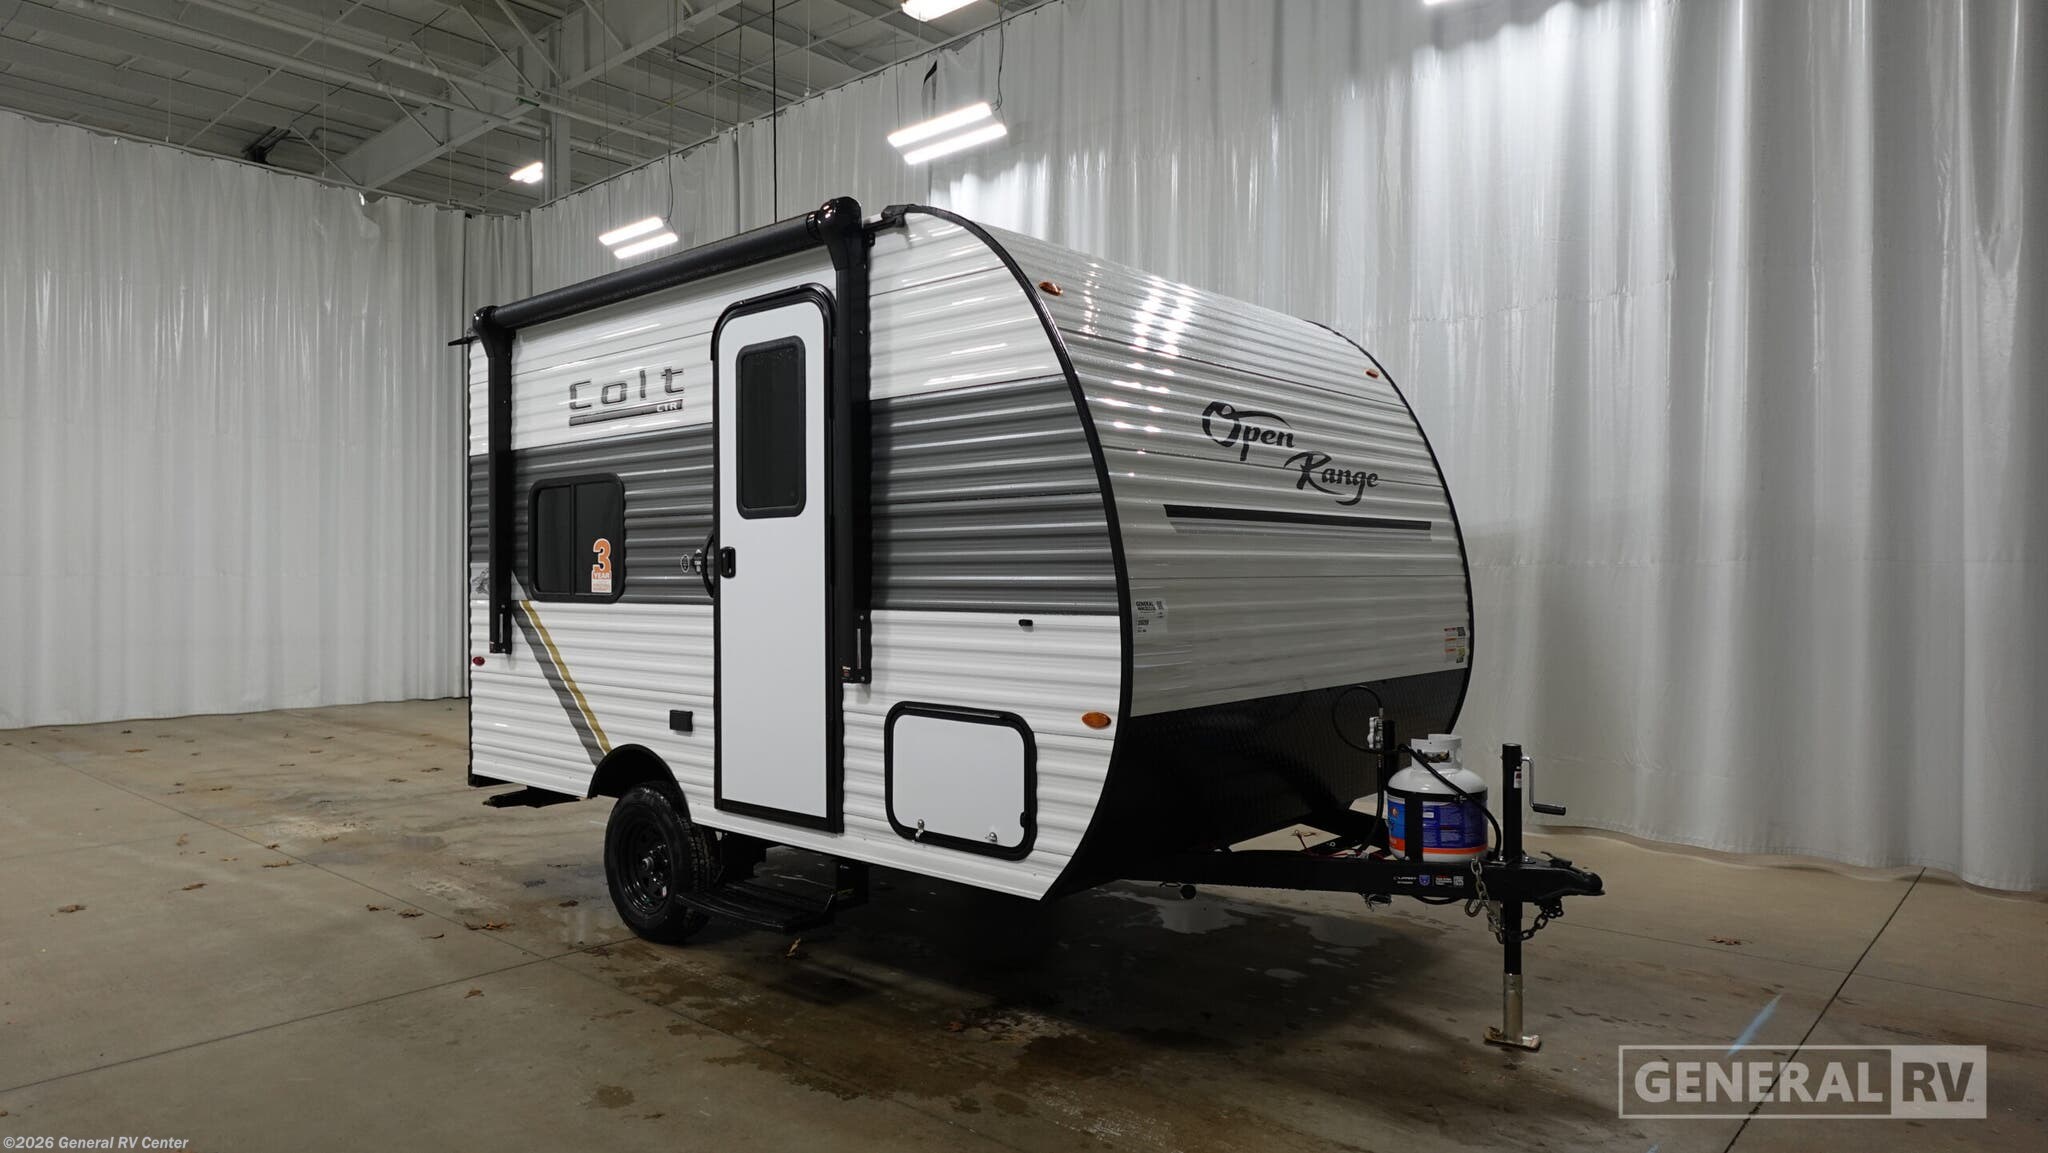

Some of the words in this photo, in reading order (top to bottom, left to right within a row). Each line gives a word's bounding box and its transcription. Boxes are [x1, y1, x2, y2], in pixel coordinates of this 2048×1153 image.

[569, 368, 684, 410] Colt
[656, 402, 677, 412] CTR
[1202, 401, 1295, 462] Open
[1283, 451, 1379, 506] Range
[593, 538, 611, 574] 3
